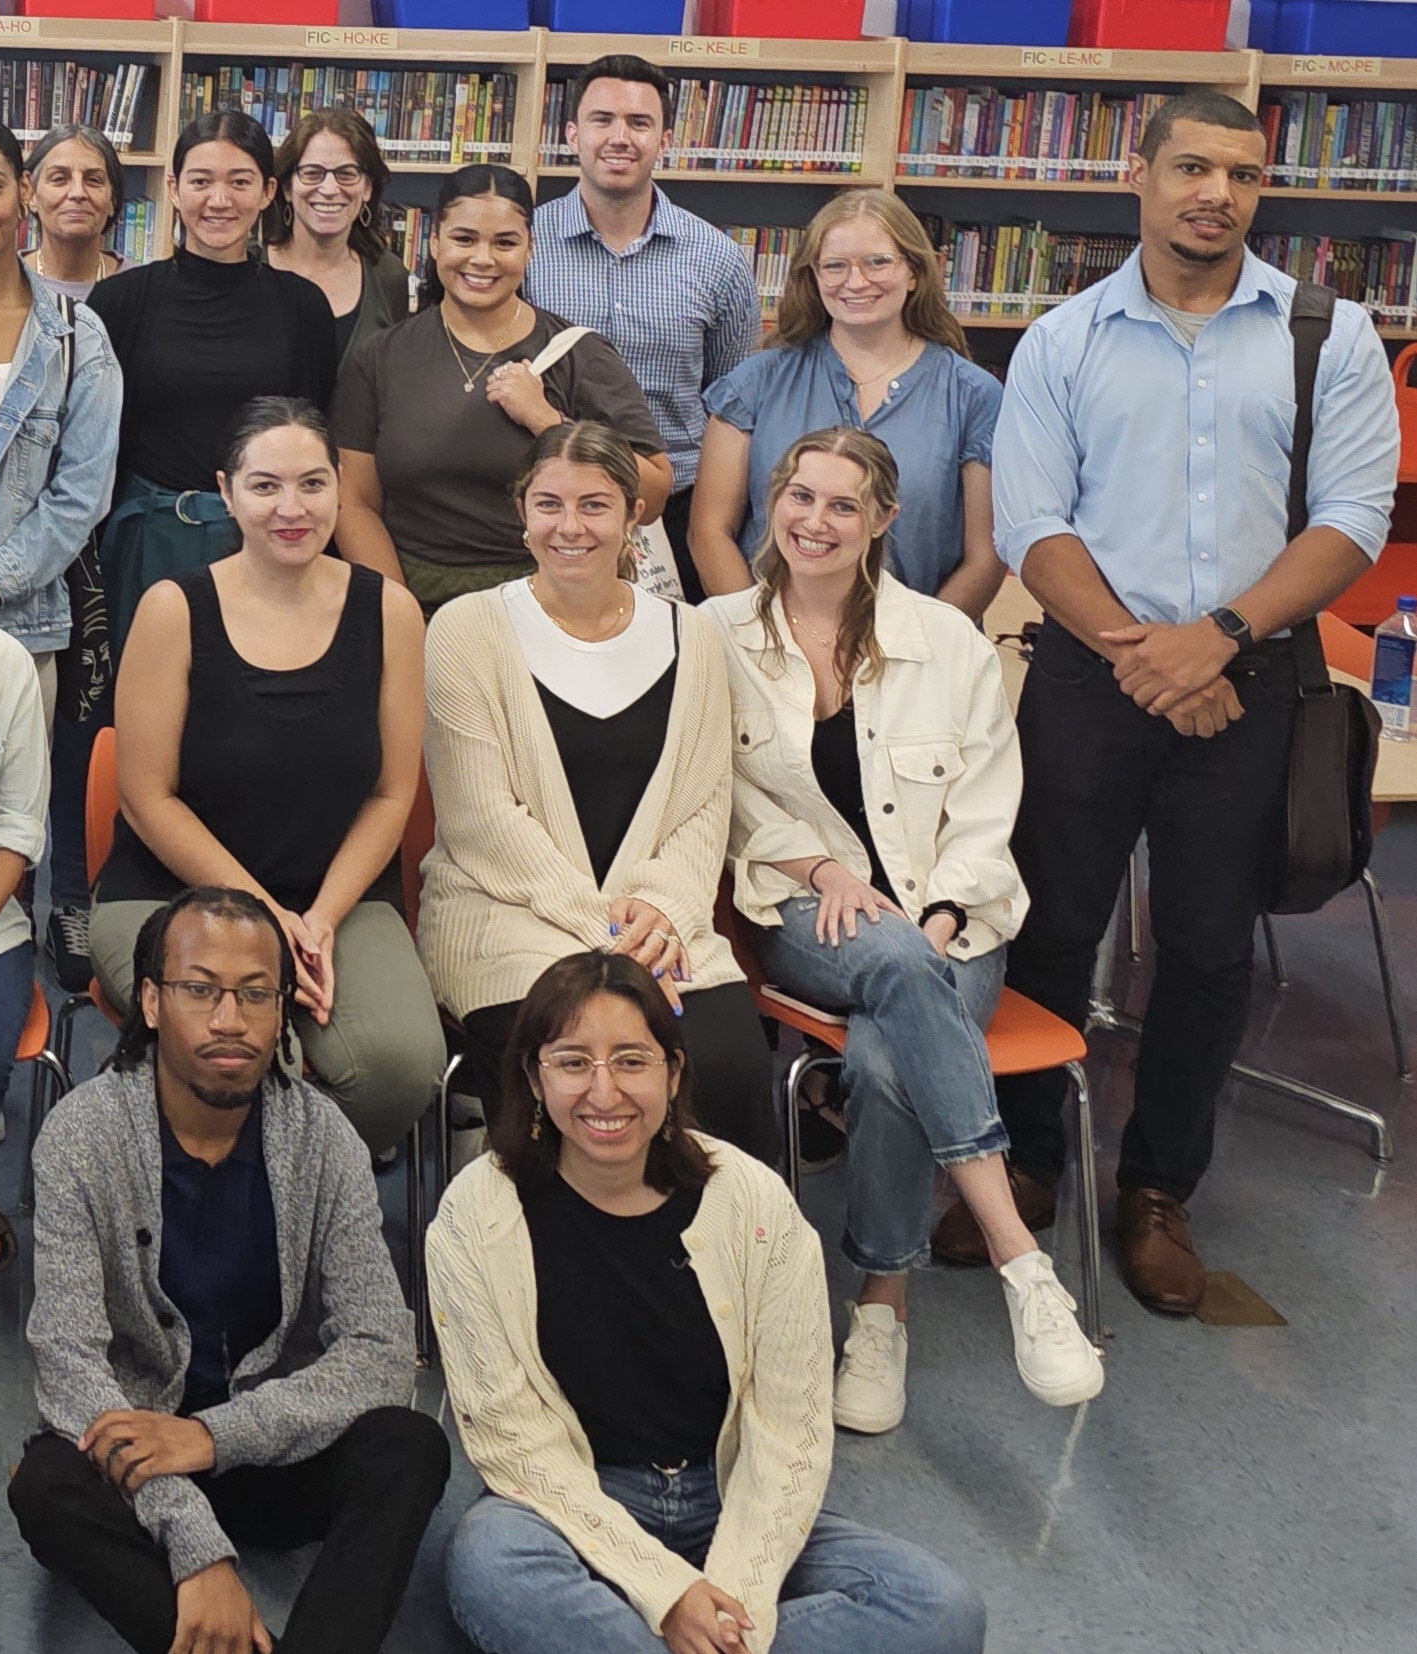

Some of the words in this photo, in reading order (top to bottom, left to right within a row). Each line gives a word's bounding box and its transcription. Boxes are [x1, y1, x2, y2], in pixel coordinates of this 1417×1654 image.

[307, 31, 332, 44] FIC
[343, 32, 390, 45] HO-KE
[670, 41, 695, 53] FIC
[706, 42, 748, 54] KE-LE
[1023, 51, 1047, 64] FIC
[1058, 52, 1104, 65] LE-MC
[1293, 59, 1316, 72] FIC
[1328, 60, 1373, 73] MC-PE
